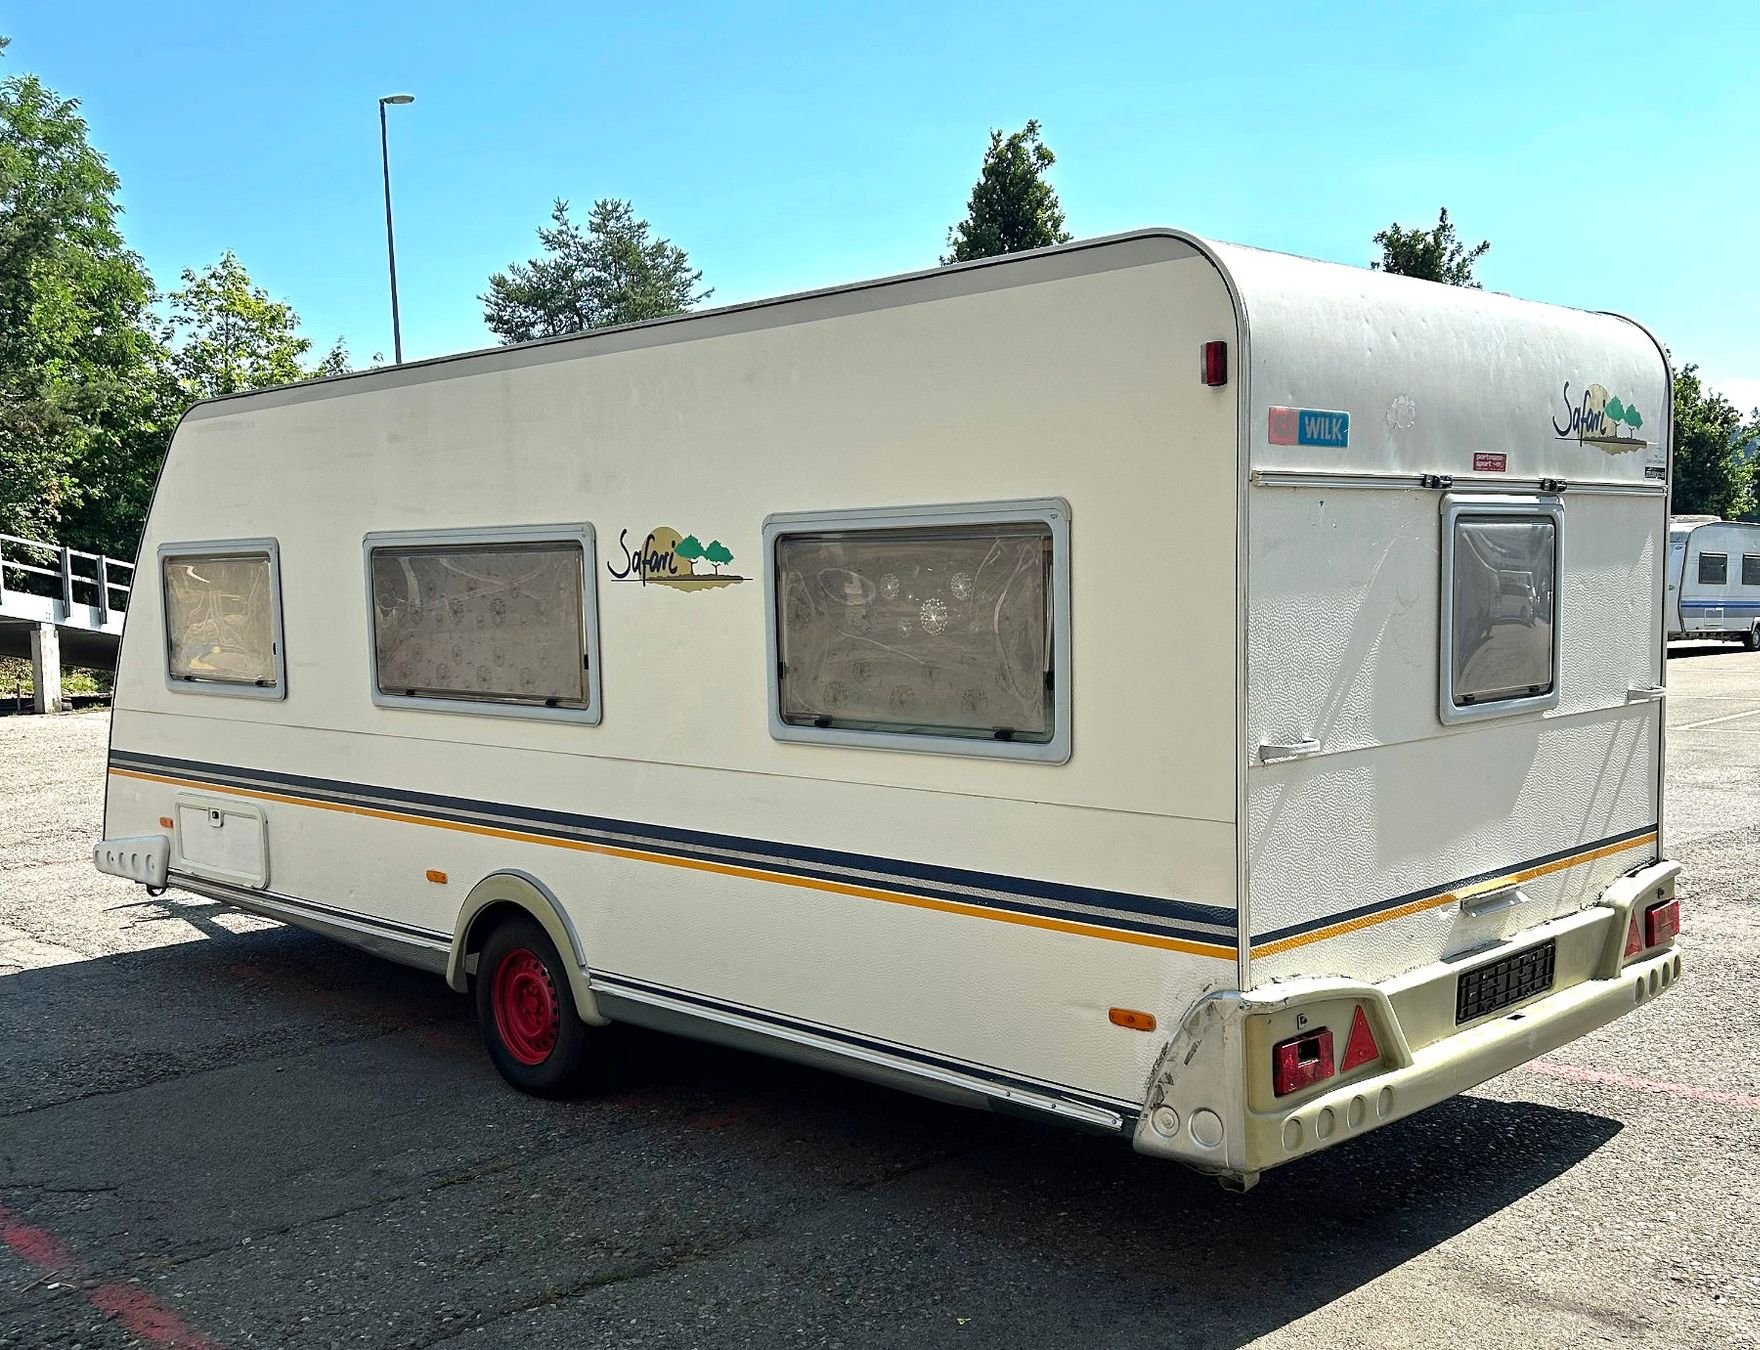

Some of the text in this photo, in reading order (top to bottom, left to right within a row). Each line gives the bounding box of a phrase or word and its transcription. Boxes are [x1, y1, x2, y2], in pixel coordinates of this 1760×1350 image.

[1304, 415, 1343, 441] WILK
[1552, 381, 1607, 447] Safari
[607, 528, 678, 587] Safari
